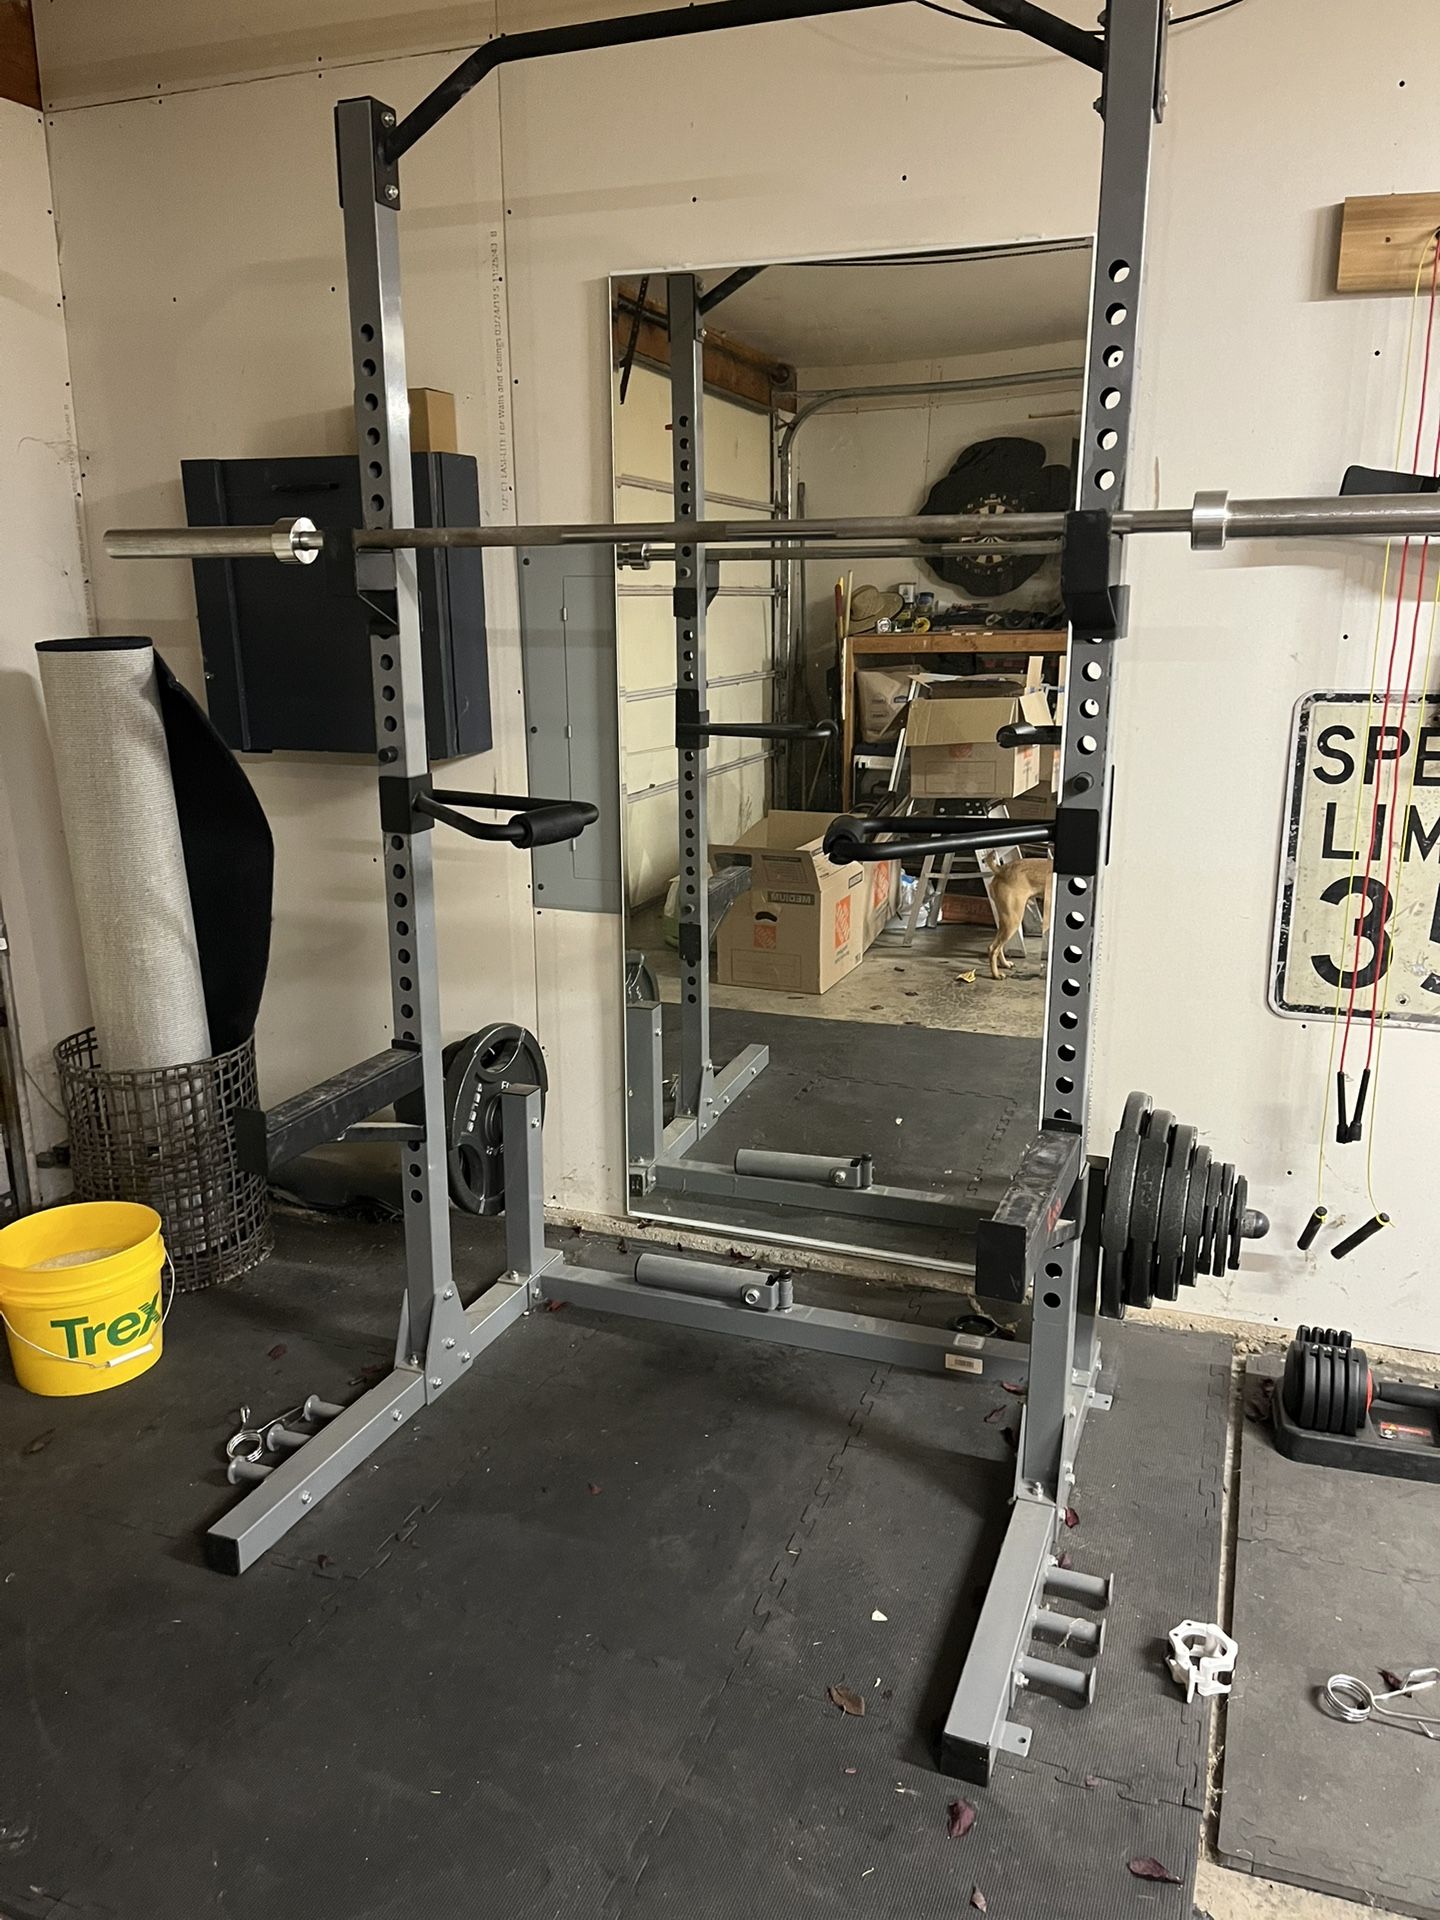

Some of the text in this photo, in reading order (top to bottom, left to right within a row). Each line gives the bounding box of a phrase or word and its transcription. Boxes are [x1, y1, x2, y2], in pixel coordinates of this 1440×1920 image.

[495, 338, 504, 373] Ceilings
[497, 376, 505, 392] and
[498, 395, 506, 418] Walls
[50, 1291, 161, 1359] Trex
